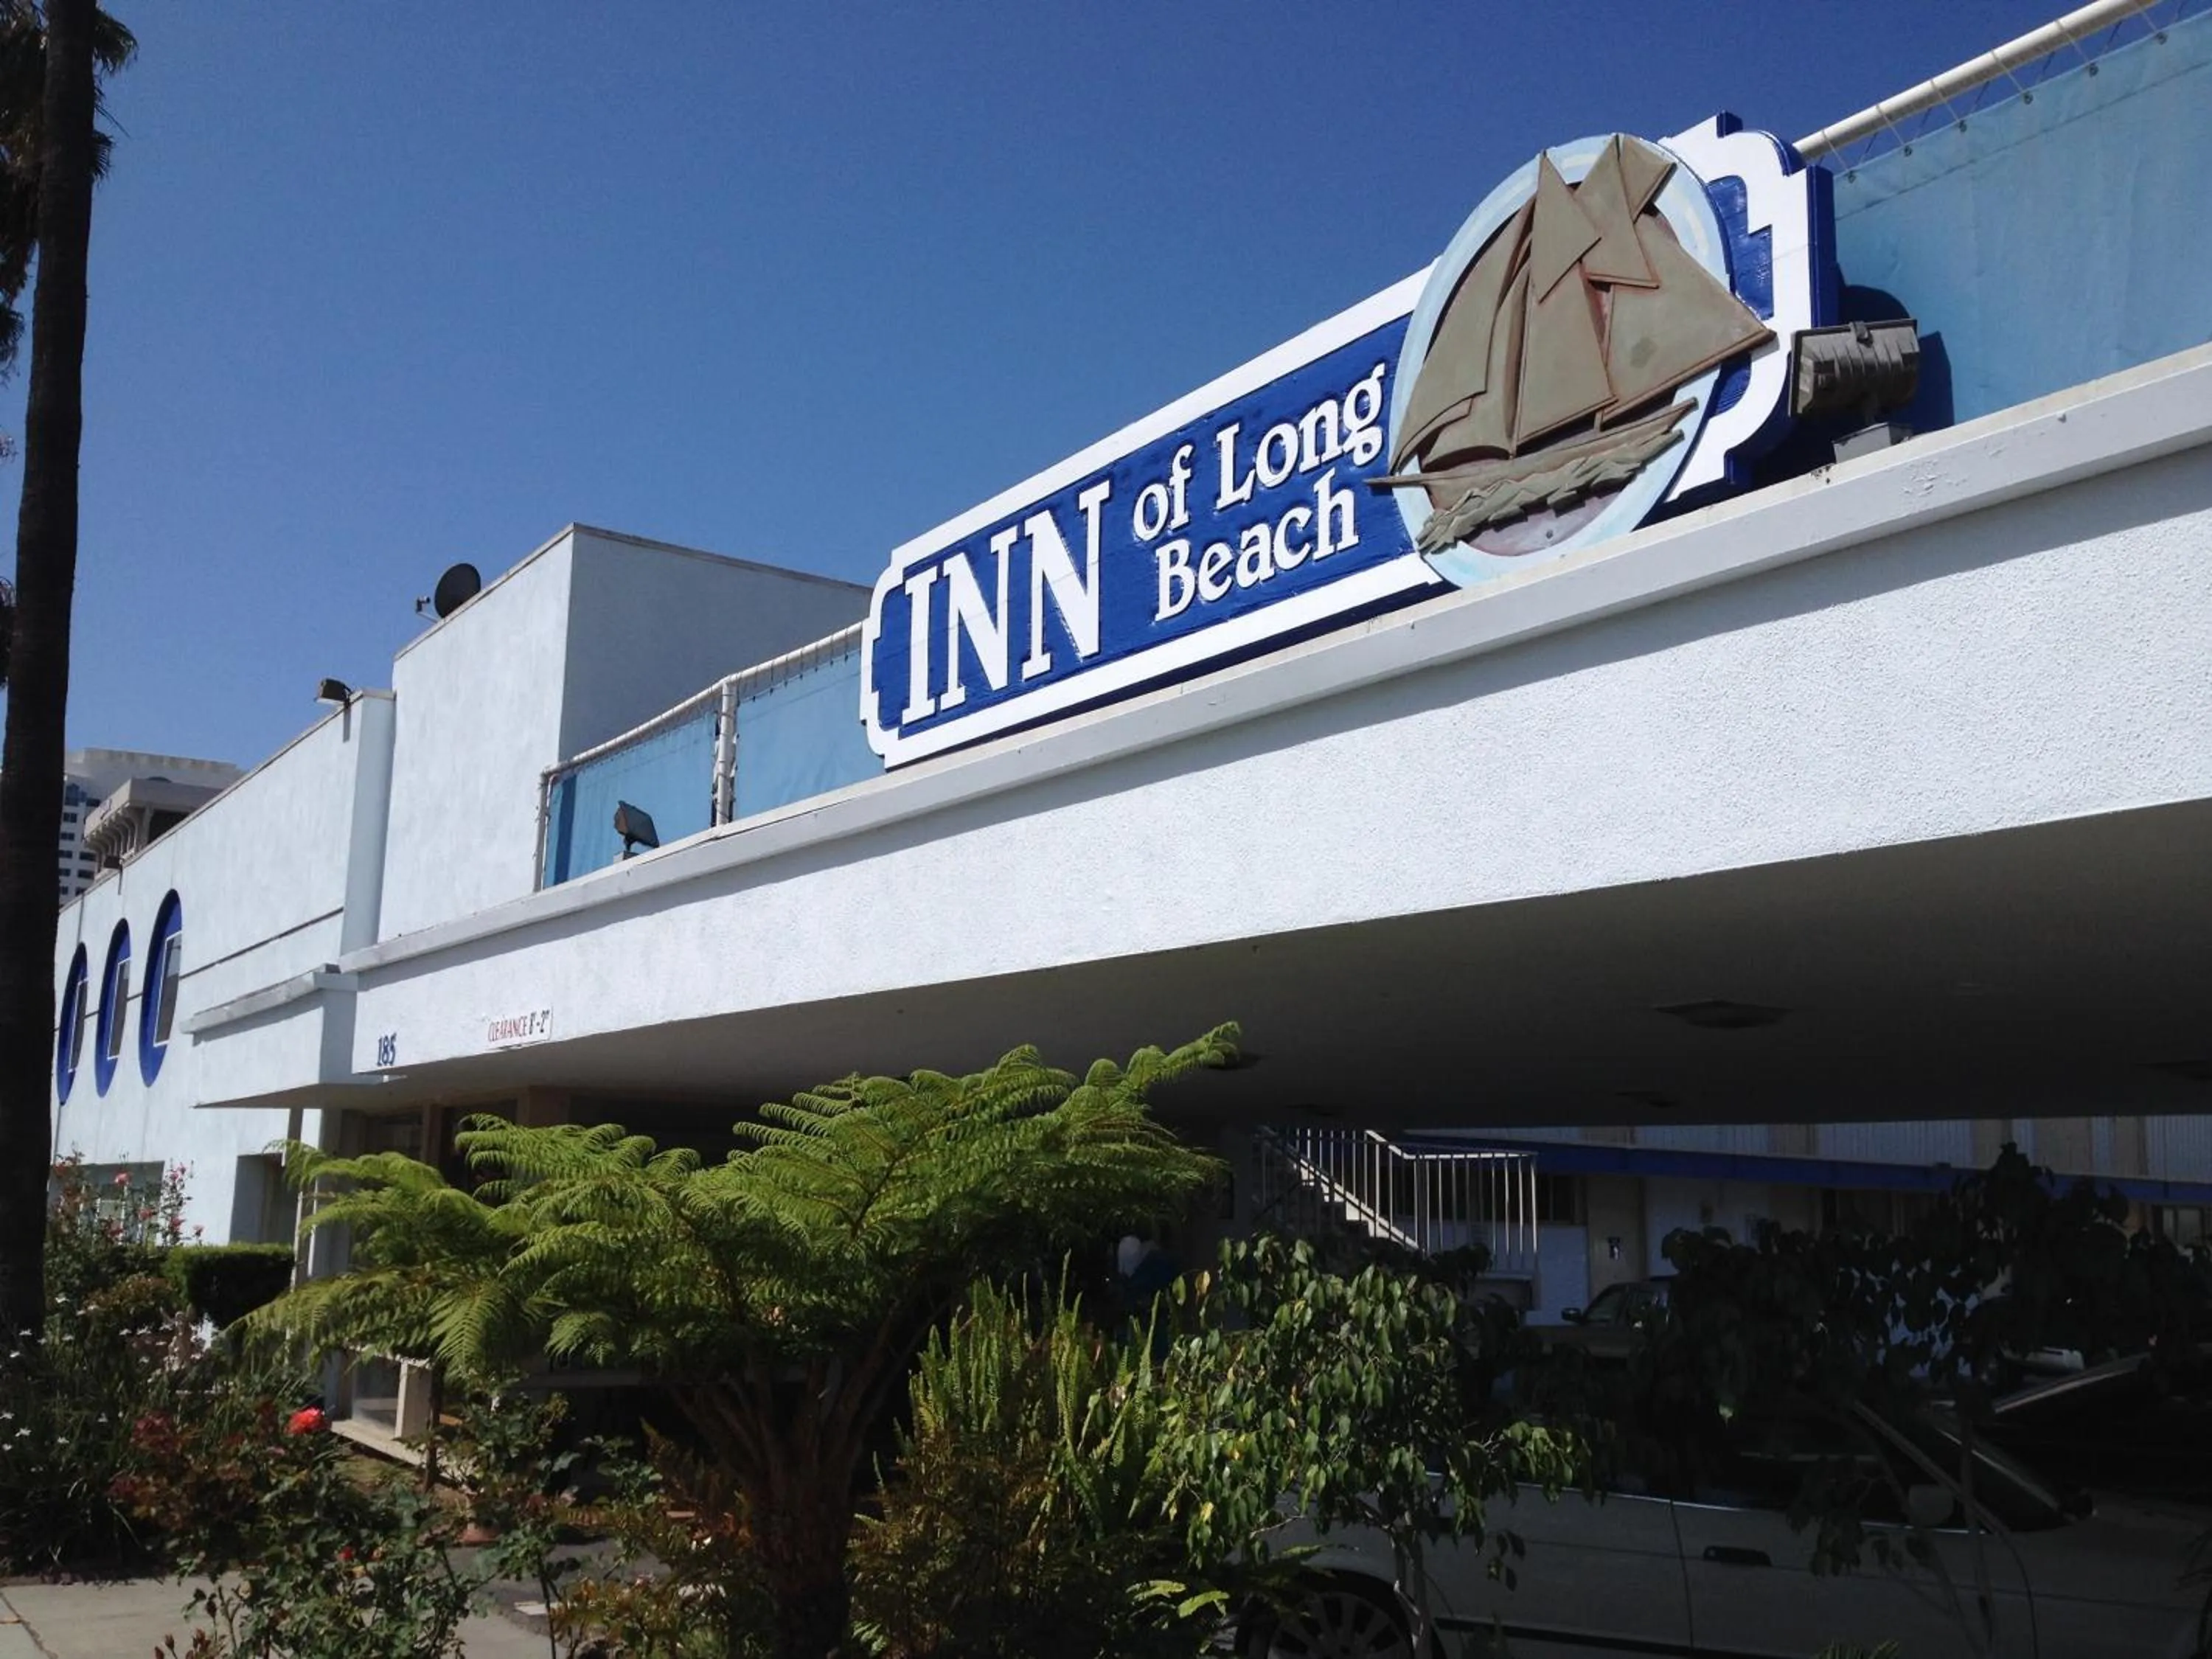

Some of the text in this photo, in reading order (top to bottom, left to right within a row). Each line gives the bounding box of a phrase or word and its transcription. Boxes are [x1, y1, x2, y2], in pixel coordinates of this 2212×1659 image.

[902, 364, 1385, 724] INN of Long
[1155, 467, 1359, 622] Beach
[377, 1032, 397, 1066] 185
